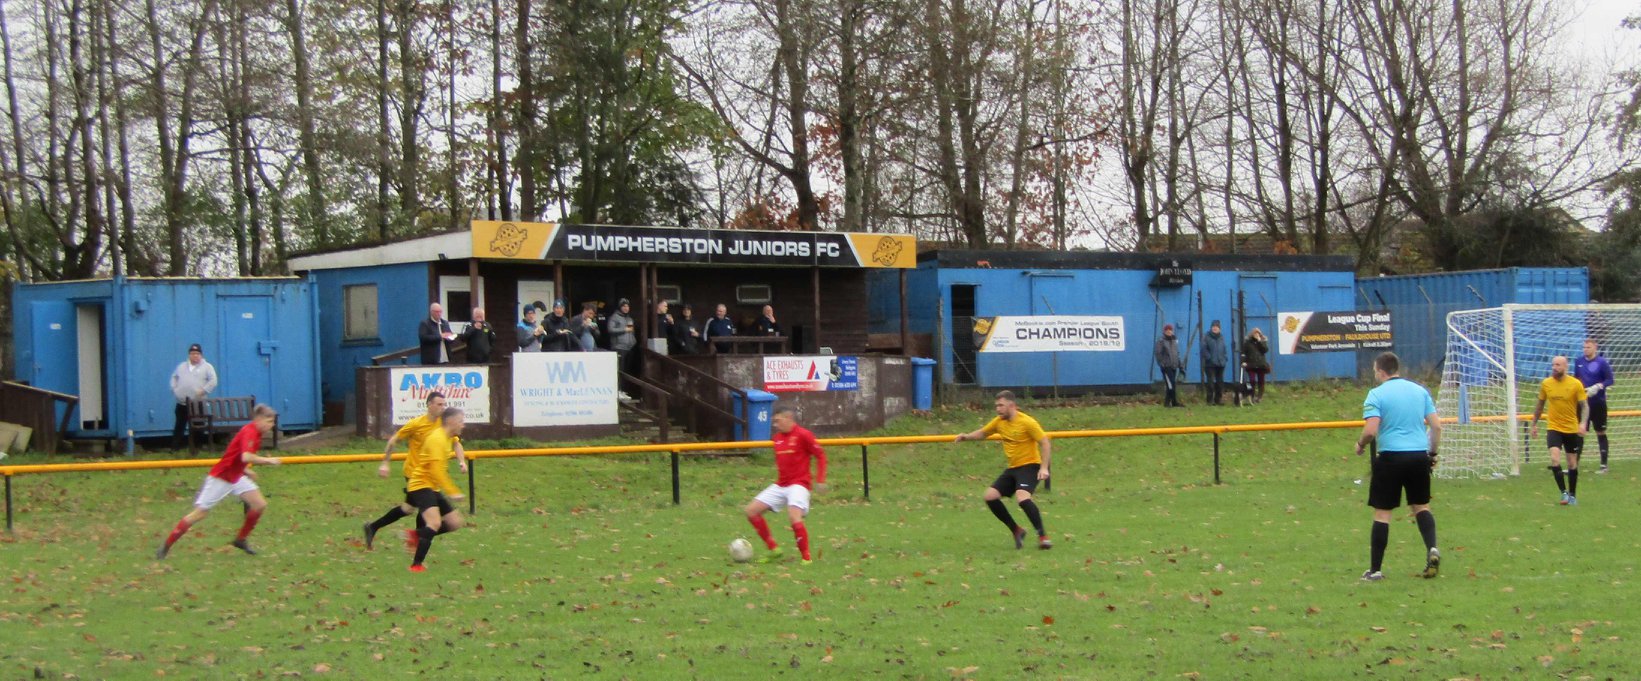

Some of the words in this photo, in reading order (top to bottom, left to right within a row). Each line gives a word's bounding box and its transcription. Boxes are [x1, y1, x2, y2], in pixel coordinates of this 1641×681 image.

[567, 234, 722, 255] PUMPHERSTON
[728, 240, 810, 257] JUNIORS
[816, 242, 840, 257] FC
[1327, 315, 1355, 325] League
[1356, 314, 1371, 324] Cup
[1372, 313, 1390, 323] Final
[1015, 327, 1120, 340] CHAMPIONS
[1368, 323, 1391, 332] Sunday
[545, 360, 587, 384] WM
[399, 371, 483, 391] AKRO
[520, 388, 553, 397] WRIGHT
[757, 410, 768, 422] 45
